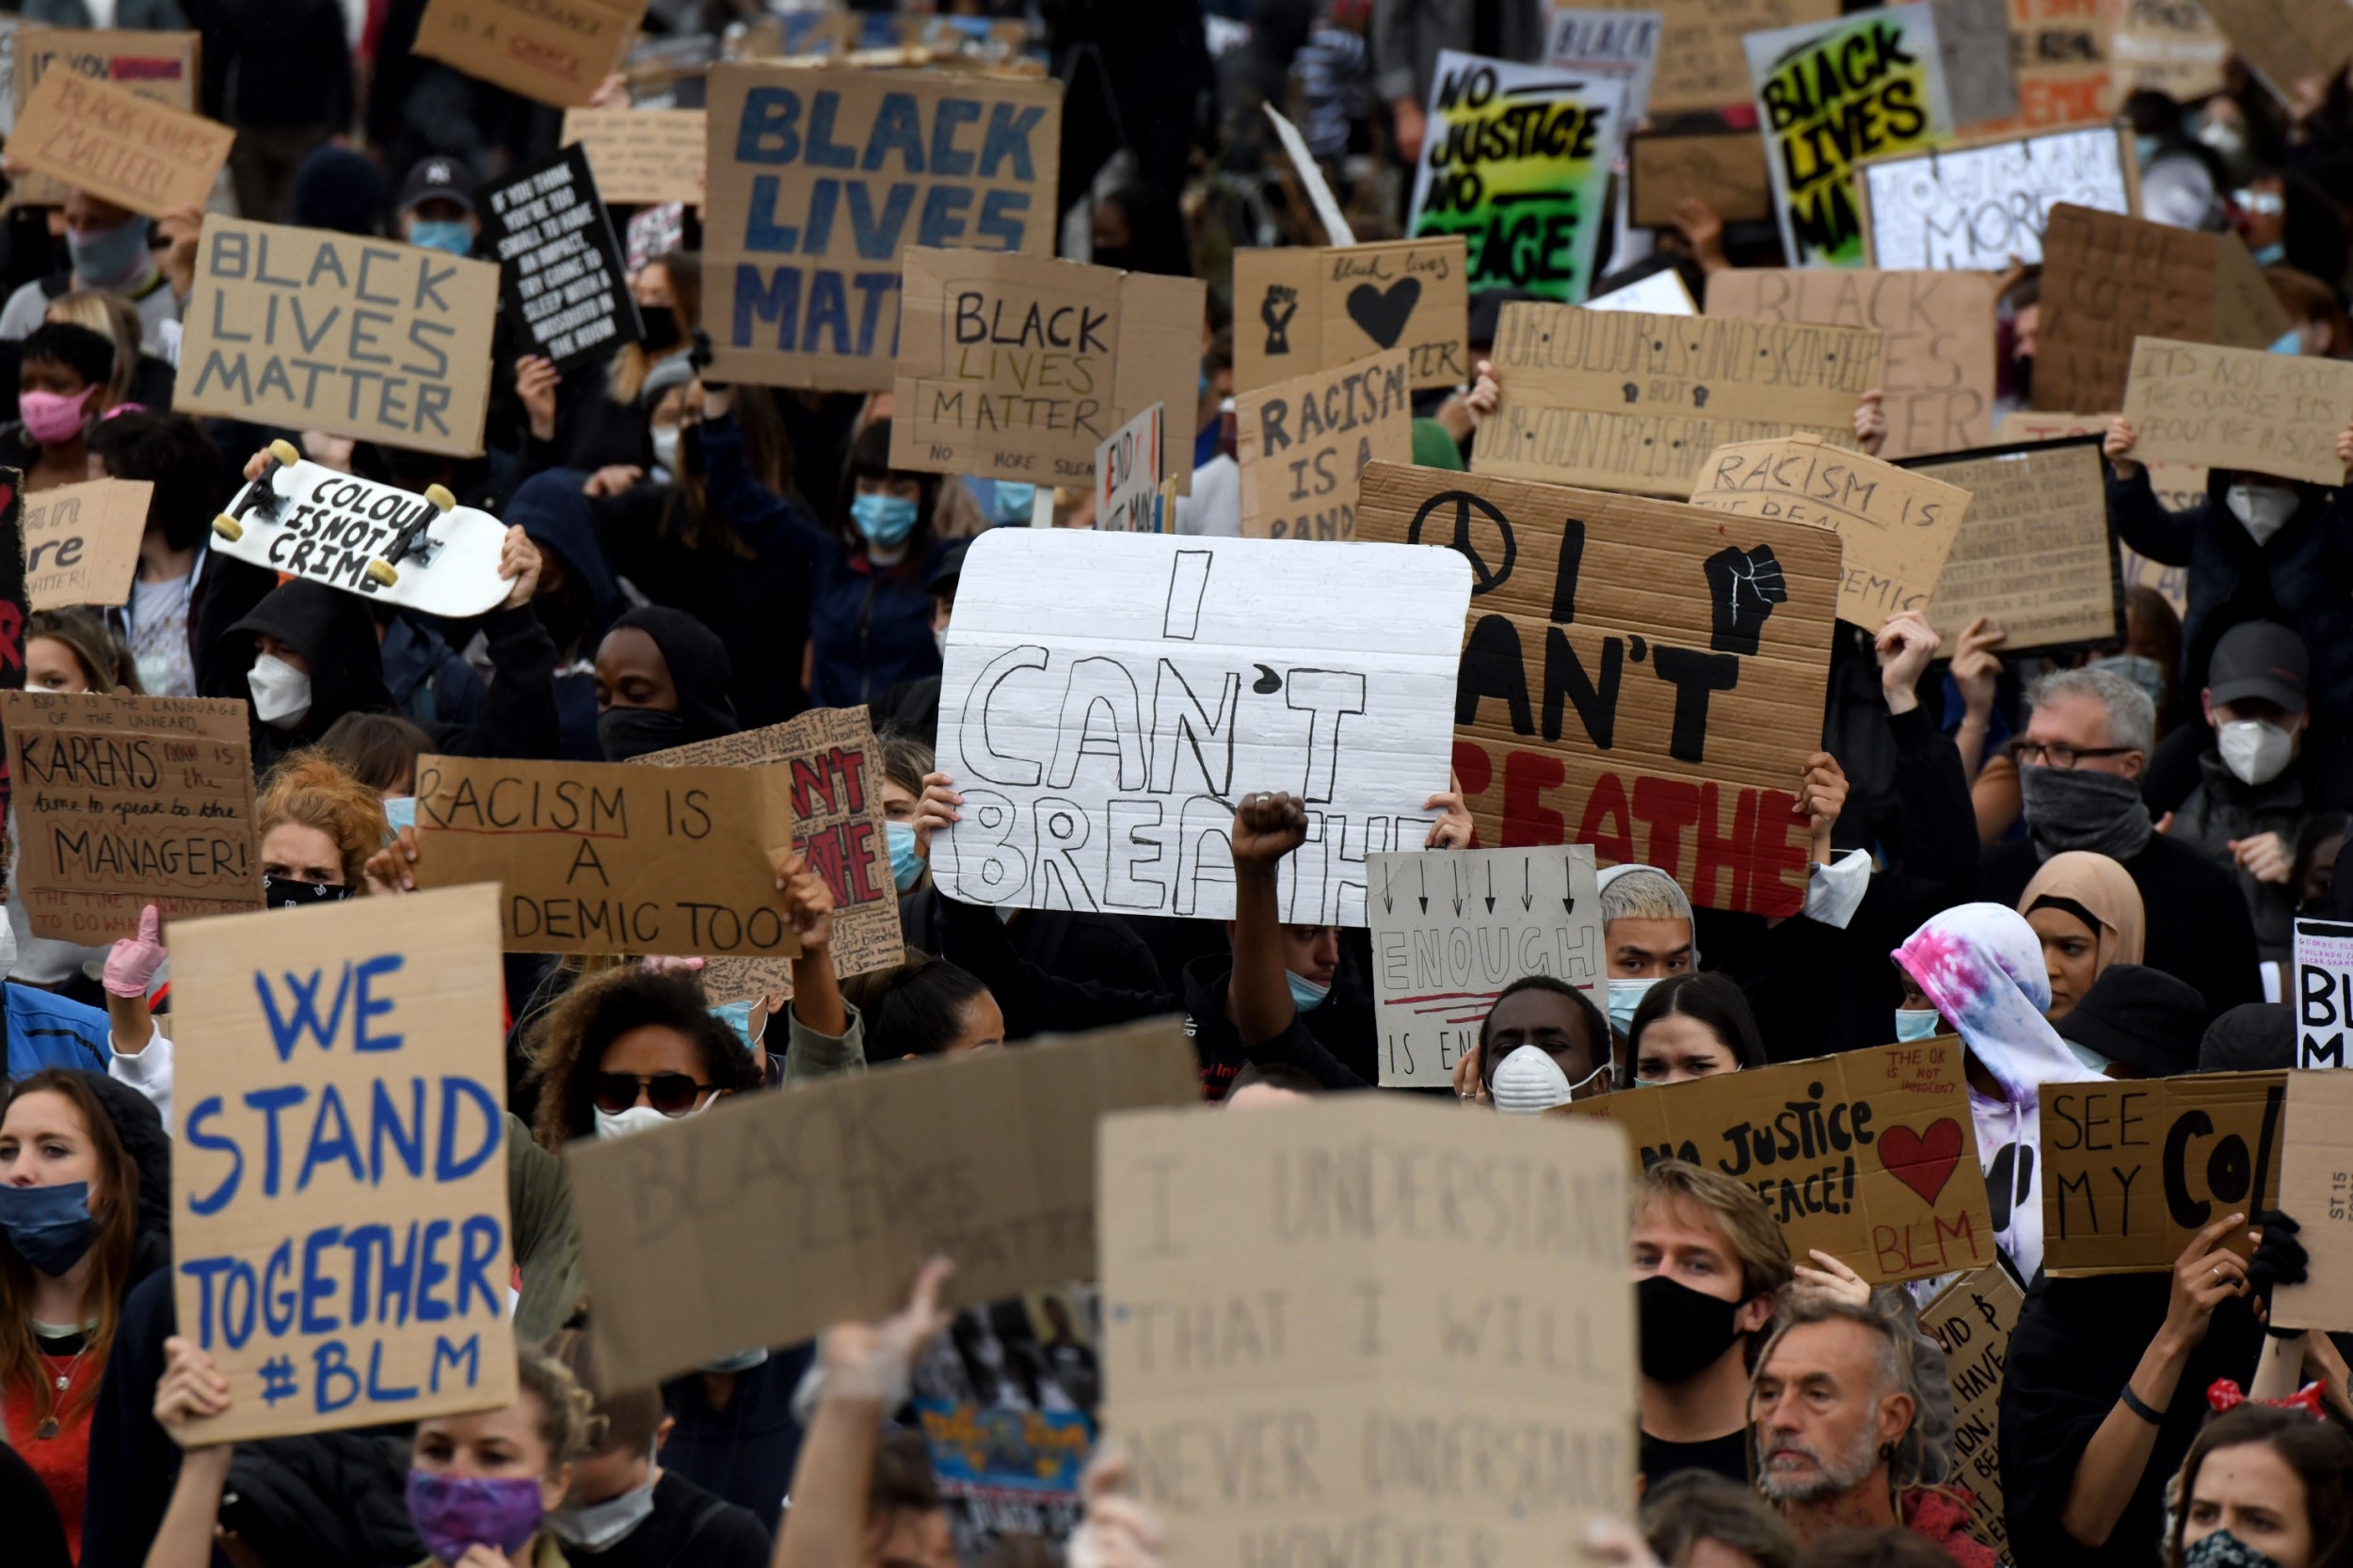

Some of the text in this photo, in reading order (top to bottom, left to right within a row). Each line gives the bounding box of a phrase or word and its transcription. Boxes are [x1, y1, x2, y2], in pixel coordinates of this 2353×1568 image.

[52, 77, 136, 138] BLACK
[1438, 67, 1499, 109] NO
[1760, 25, 1917, 133] BLACK
[733, 86, 1048, 182] BLACK
[1429, 105, 1607, 169] JUSTICE
[1782, 75, 1927, 191] LIVES
[490, 162, 573, 216] IF YOU THINK
[549, 185, 576, 214] TOO
[744, 173, 1033, 261] LIVES
[1423, 172, 1481, 213] NO
[497, 225, 544, 262] SMALL
[540, 216, 562, 240] TO
[209, 231, 458, 312] BLACK
[521, 288, 564, 324] SLEEP
[564, 271, 602, 306] WITH
[543, 255, 586, 290] GOING
[210, 289, 456, 379] LIVES
[531, 297, 601, 344] MOSQUITO
[547, 313, 617, 361] THE ROOM
[955, 292, 1109, 354] BLACK
[1546, 308, 1657, 376] COLOUR
[1694, 318, 1762, 382] ONLY
[1763, 322, 1828, 386] SKIN
[192, 348, 453, 438] MATTER
[958, 345, 1096, 396] LIVES
[1646, 379, 1689, 403] BUT
[932, 389, 1106, 440] MATTER
[1260, 362, 1406, 458] RACISM
[930, 443, 953, 462] NO
[994, 451, 1037, 471] MORE
[1288, 445, 1338, 503] IS
[1713, 452, 1944, 527] RACISM IS
[27, 536, 85, 573] re
[1549, 518, 1586, 625] I
[1162, 550, 1213, 640] I
[9, 694, 21, 705] A
[85, 697, 99, 707] IS
[111, 697, 140, 711] THE
[152, 698, 239, 716] LANGUAGE
[49, 712, 70, 726] OF
[87, 713, 114, 725] THE
[958, 644, 1367, 805] CAN'T
[18, 733, 159, 790] KARENS
[184, 767, 222, 790] the
[33, 791, 239, 826] time to speak to the
[418, 769, 712, 840] RACISM IS
[55, 826, 248, 878] MANAGER!
[567, 837, 610, 887] A
[952, 788, 1434, 928] BREATH
[28, 891, 69, 906] THE
[83, 892, 124, 910] TIME
[37, 913, 140, 933] TO DO WHA
[676, 901, 784, 951] TOO
[1379, 925, 1597, 990] ENOUGH
[2298, 937, 2333, 950] GEORGE
[2298, 948, 2343, 959] PHILANDO
[254, 953, 406, 1064] WE
[1388, 1032, 1415, 1076] IS
[1885, 1049, 1921, 1067] THE
[1887, 1067, 1942, 1080] IS NOT
[1900, 1080, 1958, 1095] INNOCENT
[185, 1074, 504, 1217] STAND
[2053, 1091, 2152, 1152] SEE
[622, 1096, 915, 1248] BLACK
[2332, 1171, 2348, 1192] 15
[1135, 1152, 1188, 1261] I
[2056, 1163, 2142, 1240] MY
[1872, 1210, 1980, 1274] BLM
[181, 1213, 504, 1352] TOGETHER
[1130, 1282, 1617, 1384] THAT I WILL
[257, 1332, 480, 1415] #BLM
[1951, 1340, 2007, 1403] HAVE
[1129, 1408, 1325, 1504] NEVER
